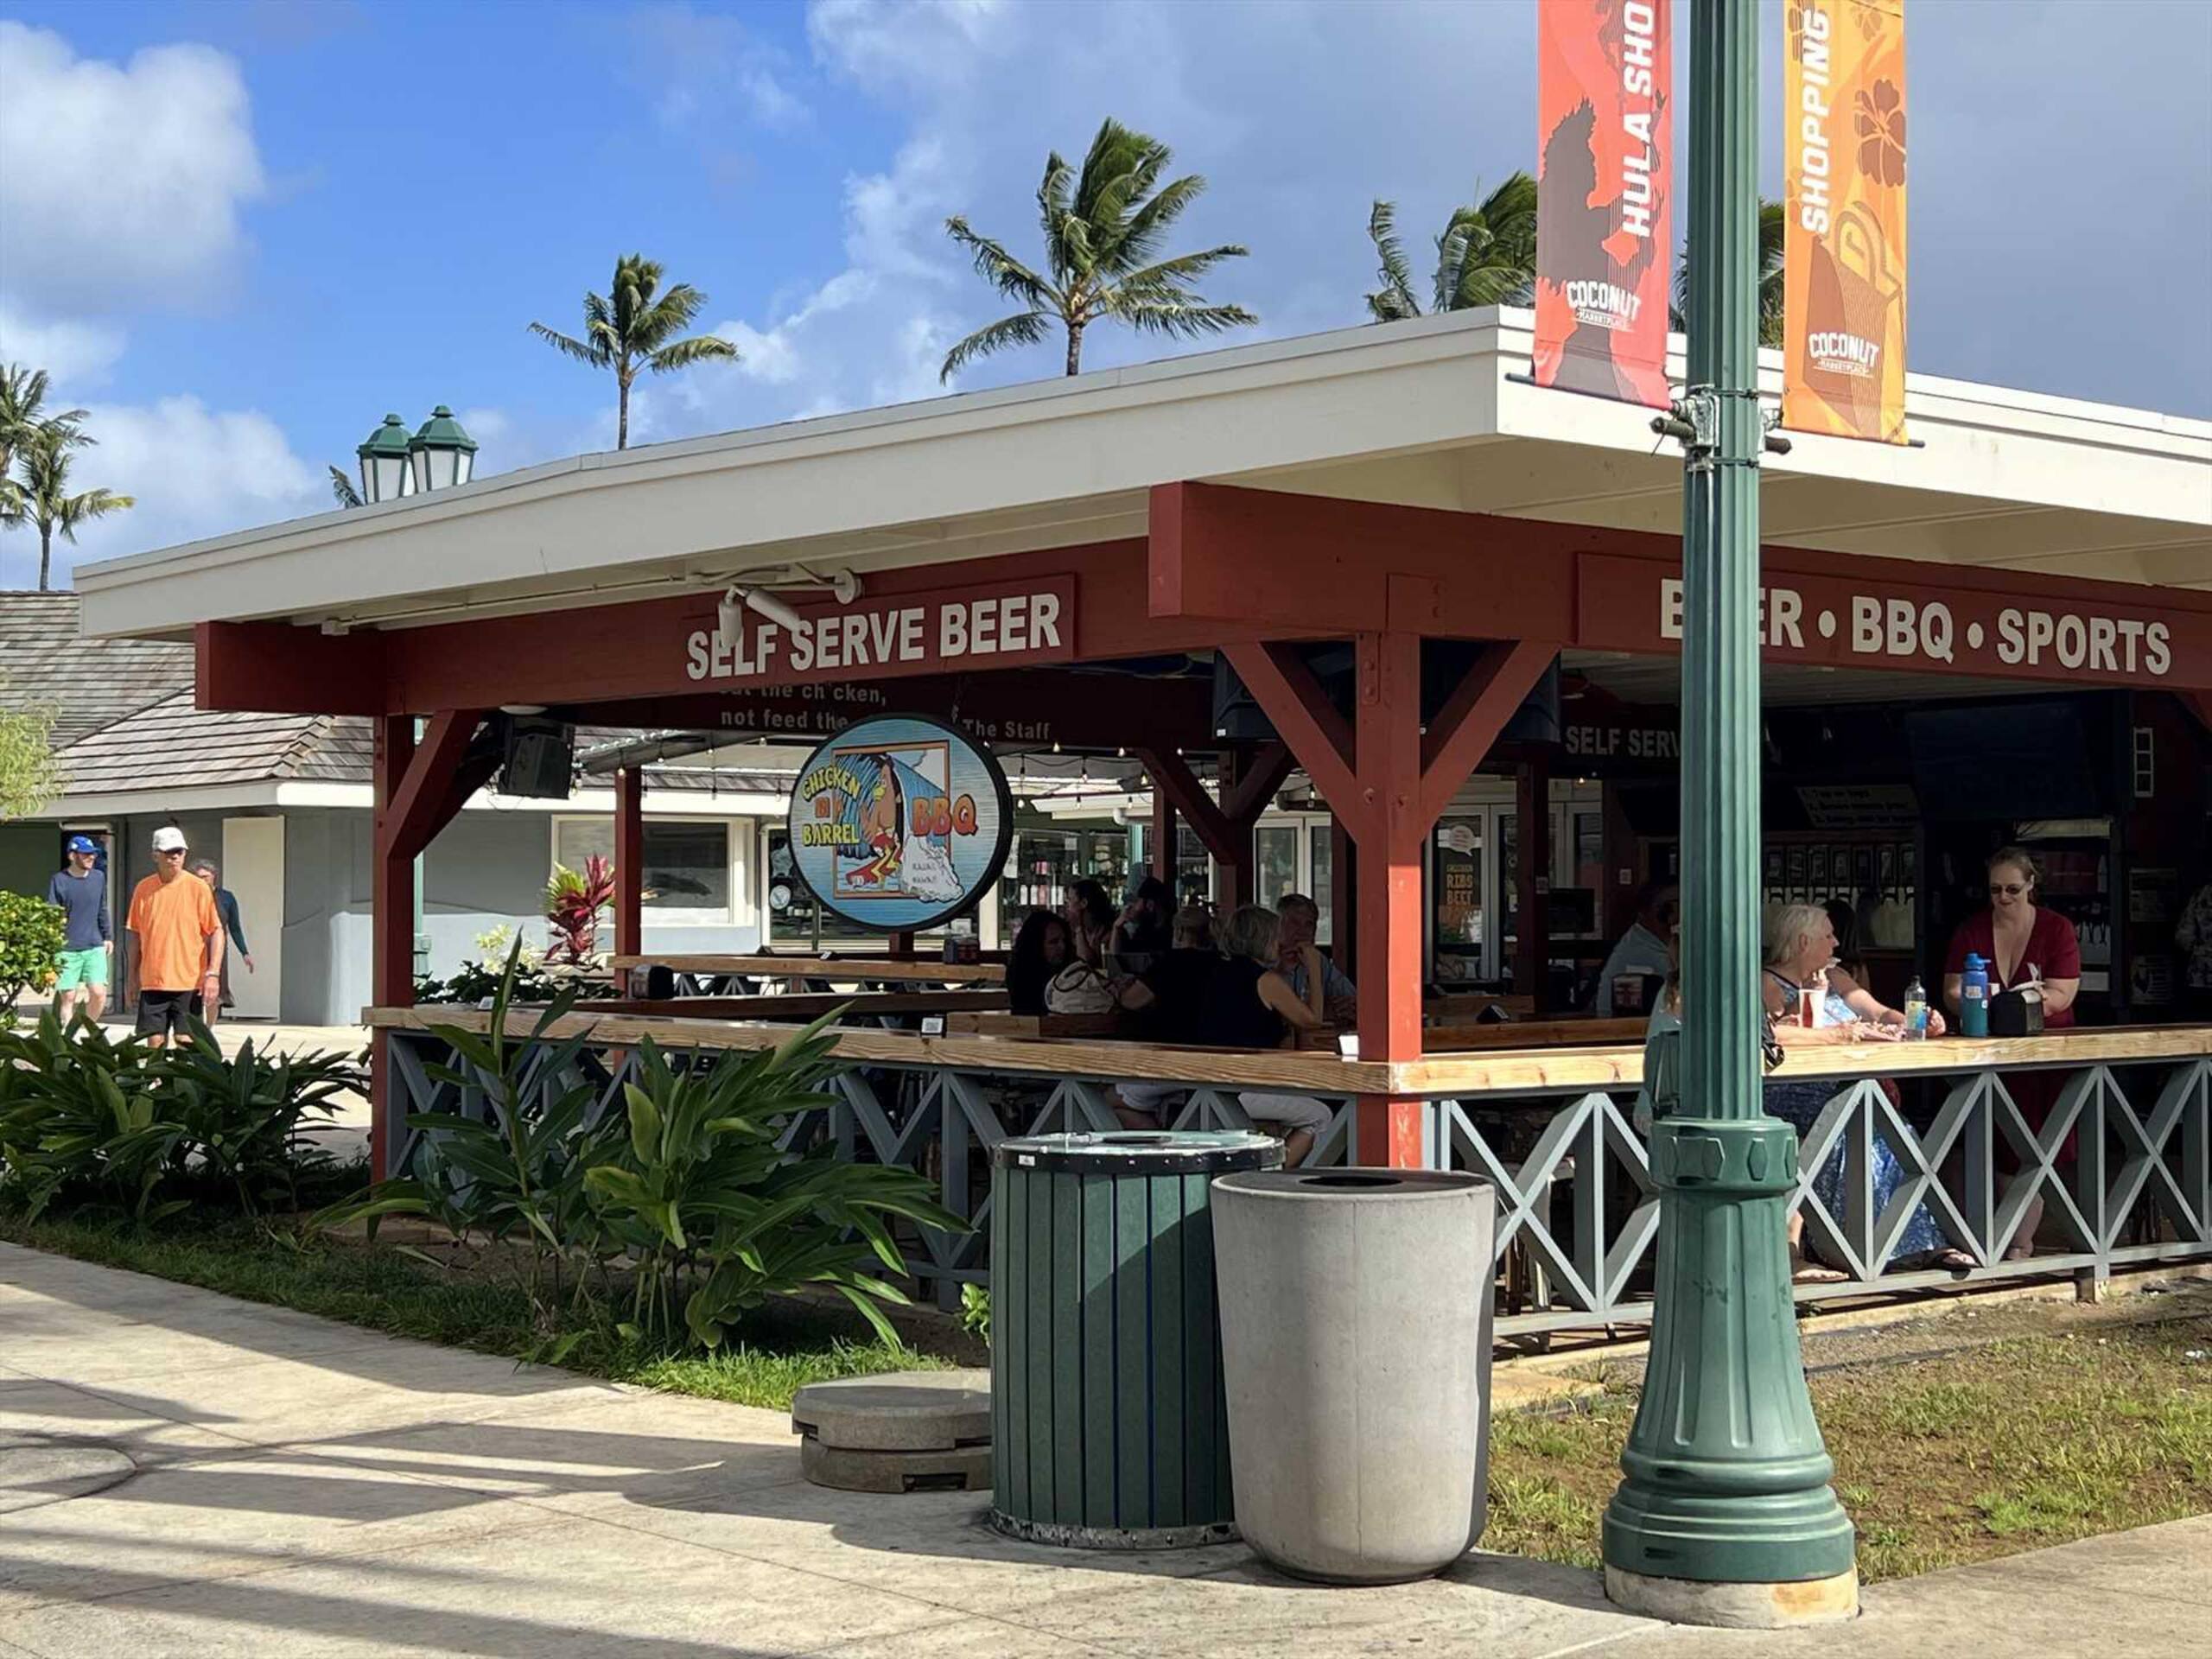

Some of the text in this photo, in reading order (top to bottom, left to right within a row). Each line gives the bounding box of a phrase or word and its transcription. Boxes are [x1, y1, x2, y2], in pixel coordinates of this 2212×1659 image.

[1800, 8, 1830, 236] SHOPPING
[1622, 112, 1651, 238] HULA
[1566, 279, 1642, 322] COCONUT
[1808, 332, 1880, 368] COCONUT
[687, 593, 1063, 681] SELF SERVE BEER
[1660, 578, 2173, 676] BR BBQ SPORTS
[720, 708, 1052, 741] not feed the The Staff
[1565, 726, 1622, 756] SELF
[802, 766, 862, 802] CHICKEN
[802, 823, 861, 847] BARREL
[912, 793, 979, 837] BBQ
